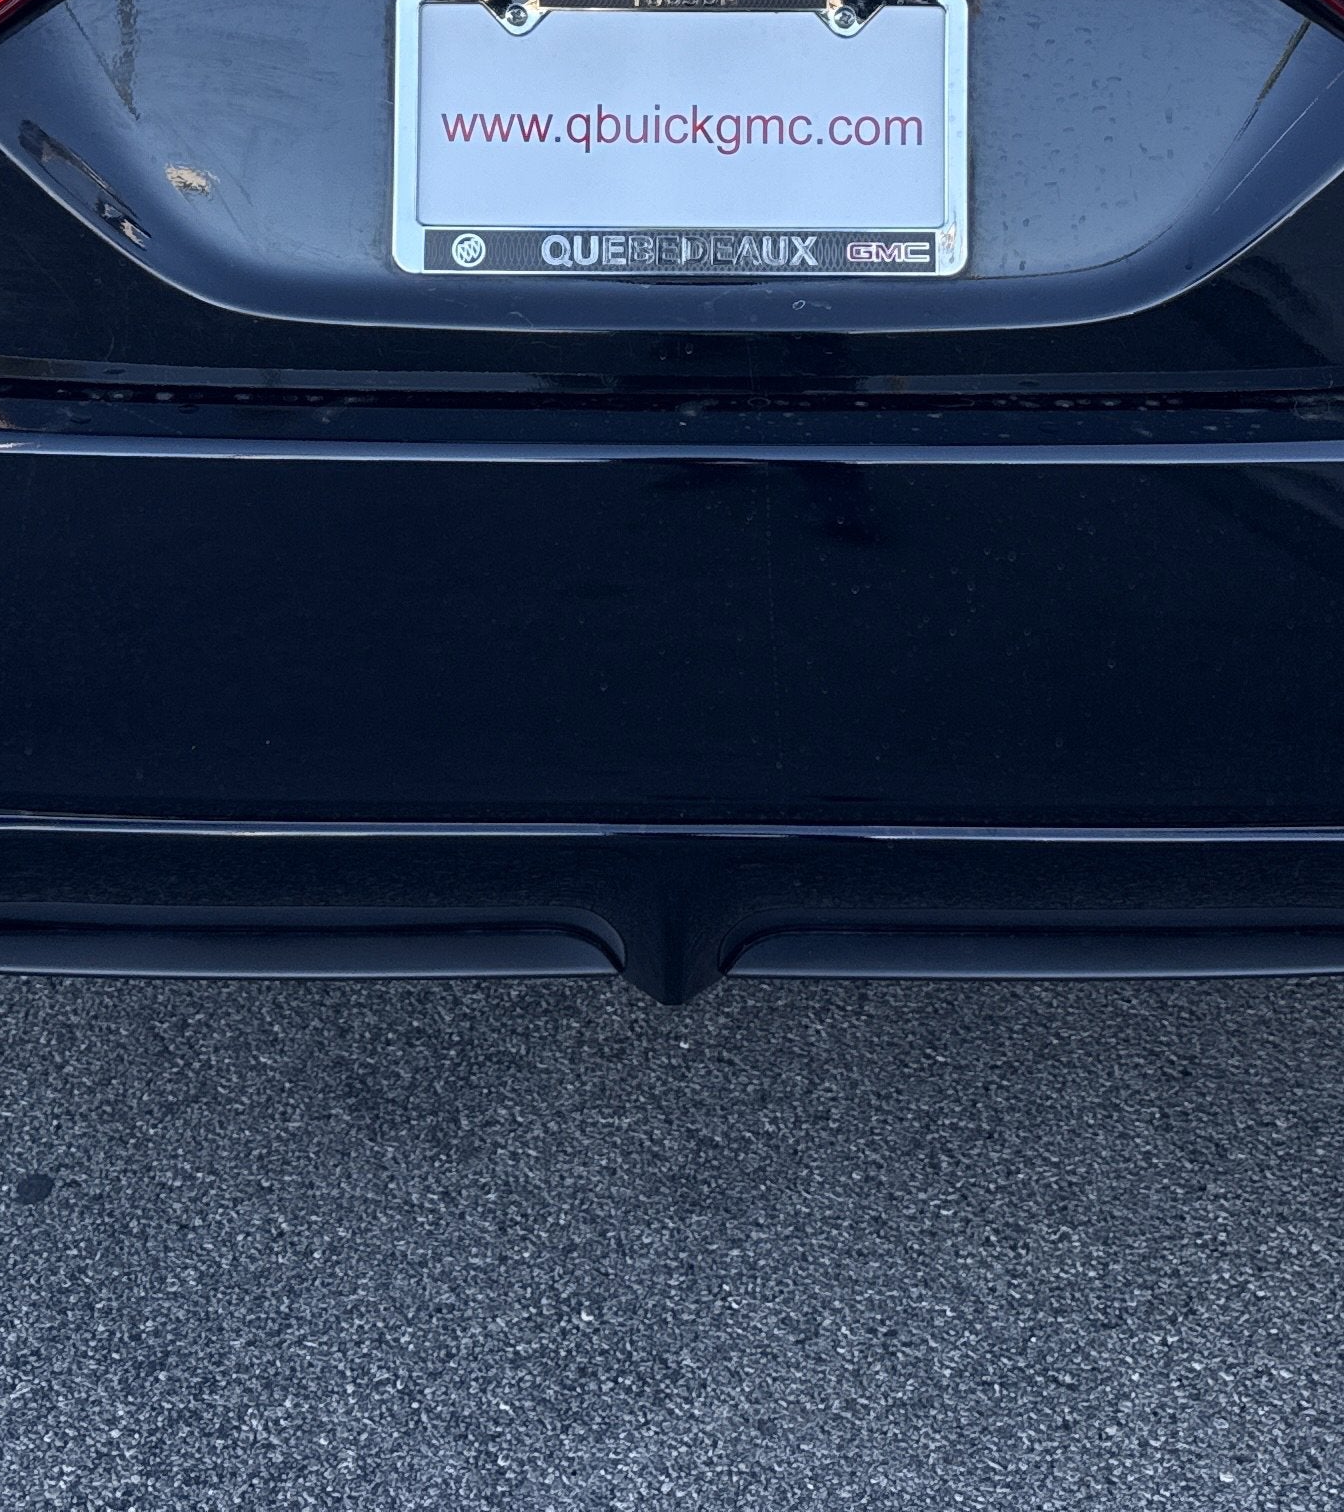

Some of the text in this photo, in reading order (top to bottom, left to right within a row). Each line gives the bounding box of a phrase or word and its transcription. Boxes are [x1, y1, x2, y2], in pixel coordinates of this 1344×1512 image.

[441, 104, 924, 155] www.qbuickgmc.com
[541, 235, 931, 267] QUEBEDEAUX GMC
